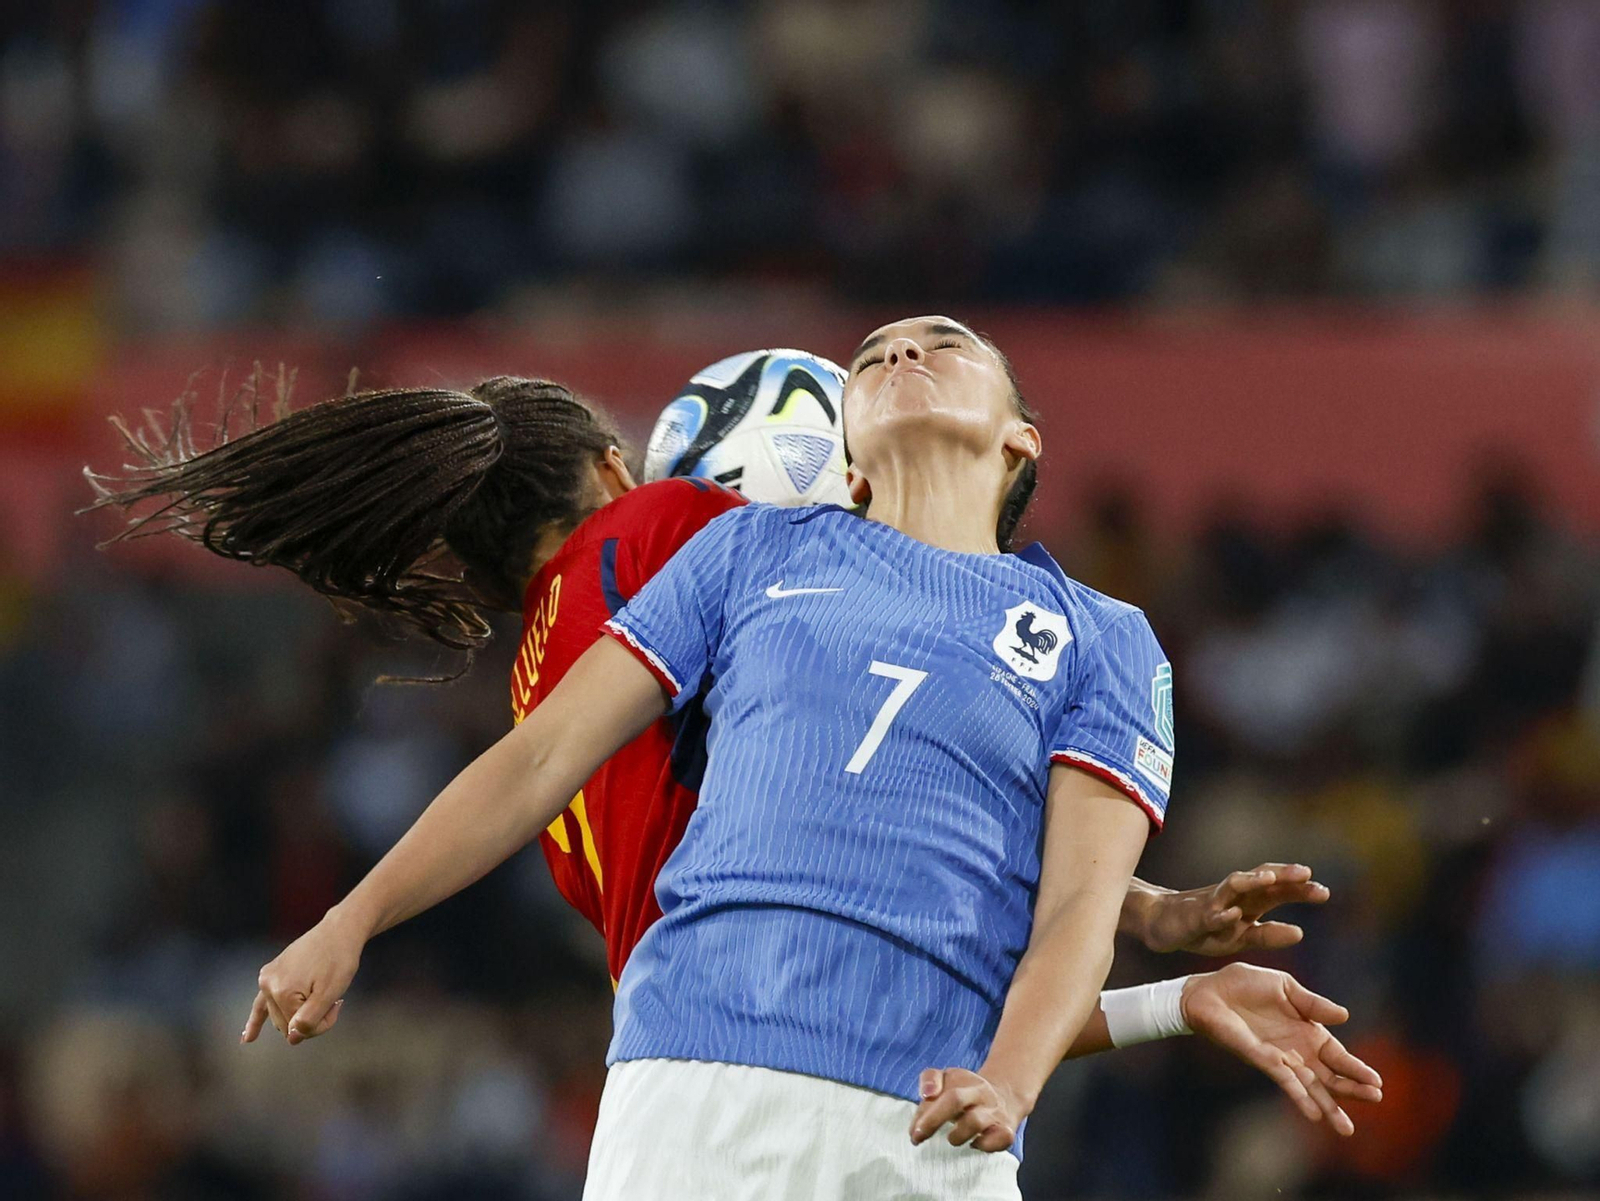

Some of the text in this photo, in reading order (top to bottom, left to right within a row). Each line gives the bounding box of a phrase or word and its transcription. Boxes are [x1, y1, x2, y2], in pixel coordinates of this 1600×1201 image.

[1022, 694, 1039, 711] 2024
[844, 659, 929, 775] 7
[1139, 739, 1156, 755] UEFA
[1137, 748, 1171, 779] FOUN
